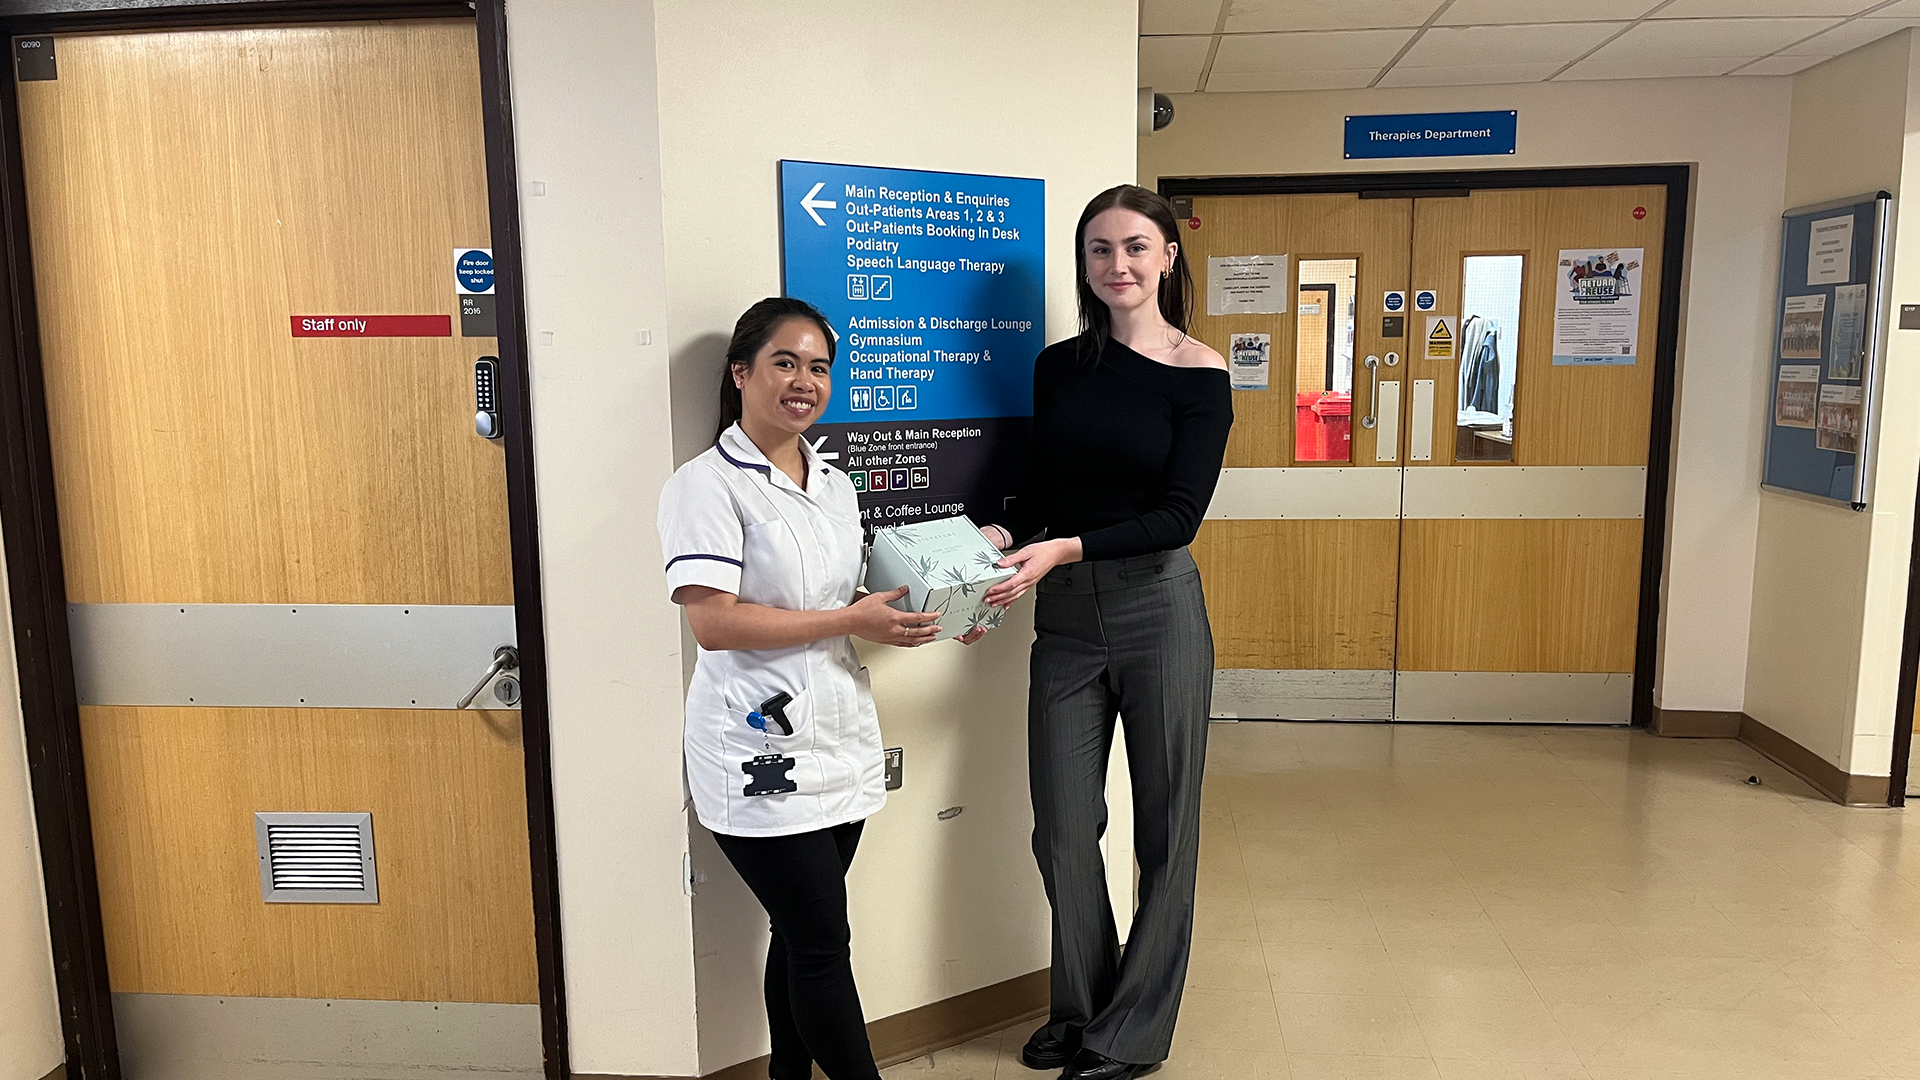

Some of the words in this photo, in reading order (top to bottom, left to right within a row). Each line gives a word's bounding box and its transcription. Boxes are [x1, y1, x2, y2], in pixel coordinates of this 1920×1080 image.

[1369, 131, 1422, 142] Therapies
[1425, 127, 1491, 141] Department
[845, 185, 875, 198] Main
[880, 187, 940, 204] Reception
[944, 192, 952, 204] &
[956, 193, 1010, 207] Enquiries
[846, 202, 922, 219] Out-Patients
[926, 207, 960, 221] Areas
[964, 209, 973, 223] 1,
[977, 210, 983, 221] 2
[987, 211, 995, 222] &
[998, 211, 1004, 222] 3
[847, 220, 923, 236] Out-Patients
[927, 224, 975, 241] Booking
[978, 227, 989, 238] In
[992, 228, 1019, 240] Desk
[847, 238, 899, 255] Podiatry
[848, 255, 893, 271] Speech
[898, 256, 955, 274] Language
[959, 259, 1004, 274] Therapy
[302, 318, 334, 332] Staff
[338, 318, 367, 334] only
[849, 317, 914, 330] Admission
[918, 318, 926, 328] &
[931, 317, 988, 332] Discharge
[992, 318, 1032, 332] Lounge
[850, 334, 922, 349] Gymnasium
[850, 350, 930, 364] Occupational
[934, 350, 980, 364] Therapy
[983, 350, 991, 361] &
[851, 367, 882, 380] Hand
[886, 367, 934, 381] Therapy
[847, 432, 870, 446] Way
[873, 430, 892, 442] Out
[895, 430, 903, 441] &
[906, 429, 930, 440] Main
[932, 427, 981, 440] Reception
[848, 444, 866, 454] (Blue
[869, 443, 886, 452] Zone
[888, 442, 904, 451] front
[905, 441, 938, 451] entrance)
[848, 457, 863, 467] All
[865, 455, 892, 466] other
[895, 454, 927, 464] Zones
[854, 476, 862, 487] G
[875, 475, 883, 485] R
[896, 474, 903, 484] P
[914, 473, 927, 484] Bn
[874, 506, 882, 518] &
[886, 505, 921, 517] Coffee
[925, 502, 964, 514] Lounge
